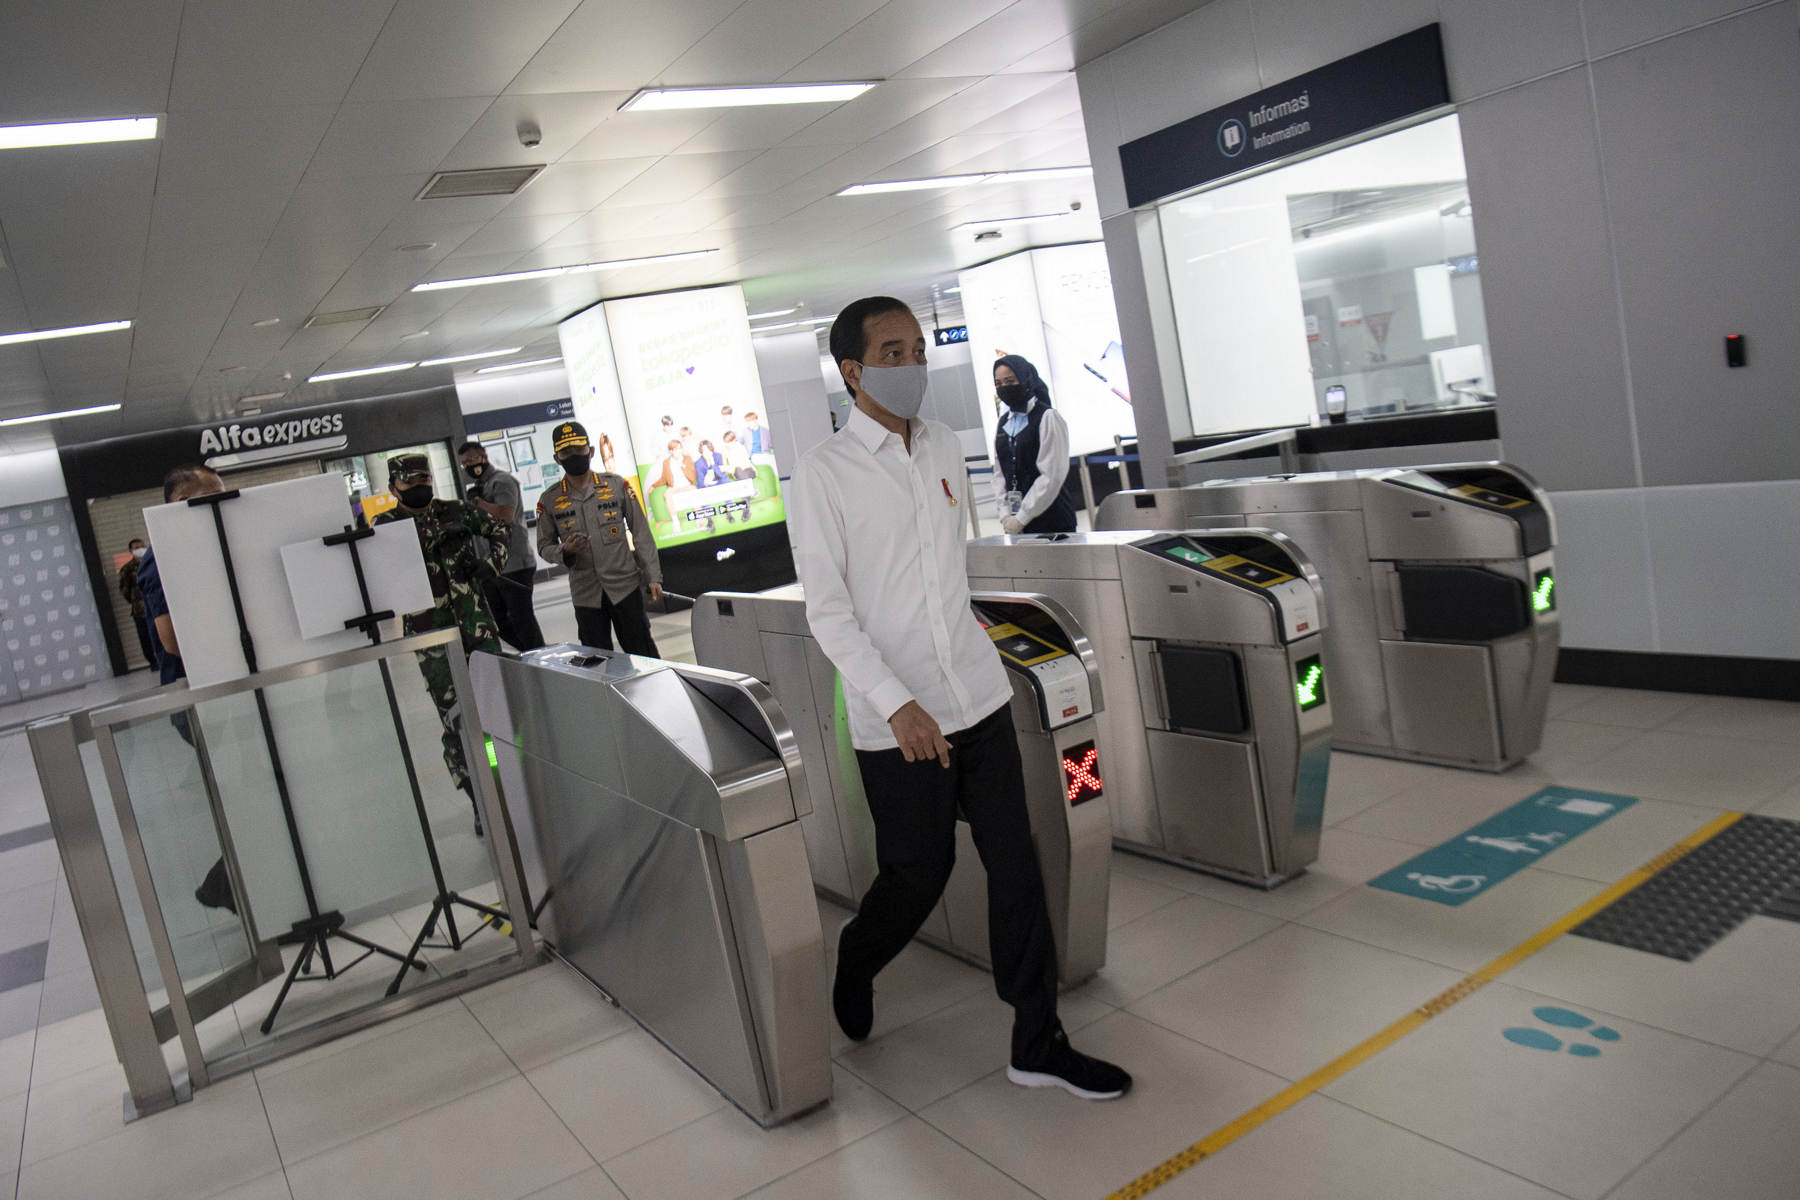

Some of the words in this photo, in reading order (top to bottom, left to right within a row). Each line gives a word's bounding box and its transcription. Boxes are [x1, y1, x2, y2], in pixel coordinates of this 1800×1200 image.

[1248, 90, 1310, 128] Informasi
[1253, 121, 1312, 150] Information
[200, 413, 343, 455] Alfaexpress
